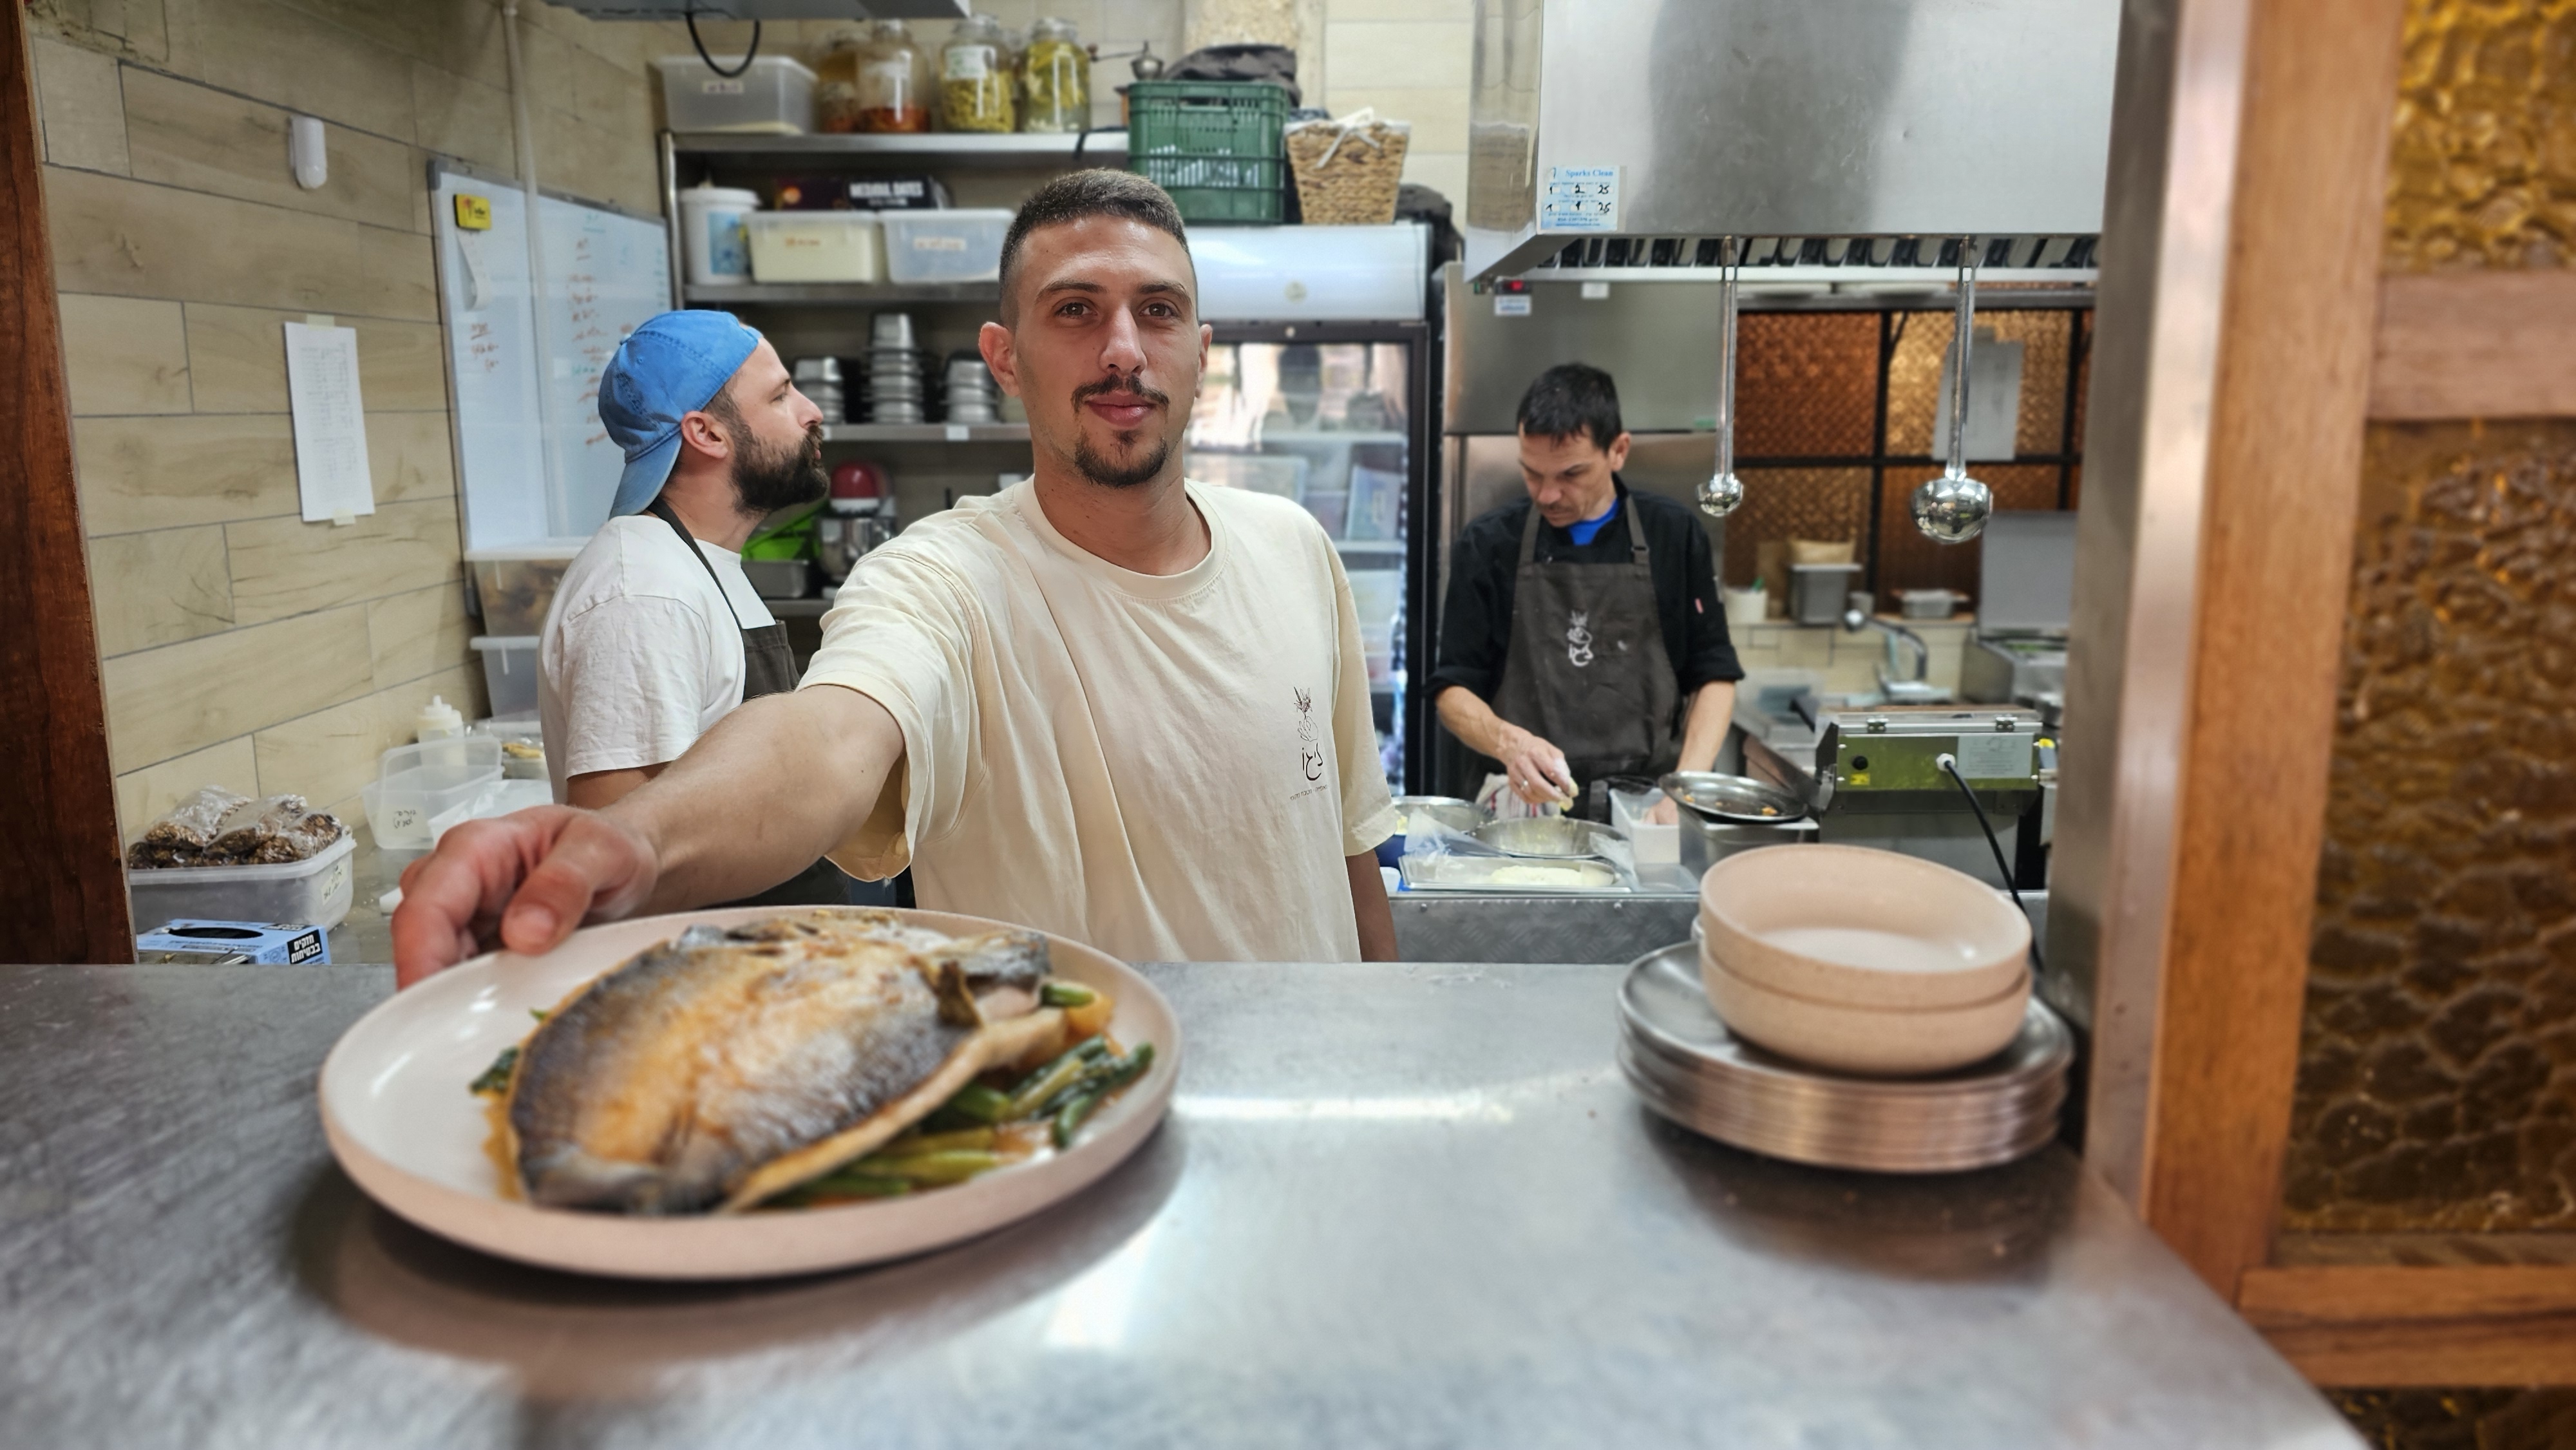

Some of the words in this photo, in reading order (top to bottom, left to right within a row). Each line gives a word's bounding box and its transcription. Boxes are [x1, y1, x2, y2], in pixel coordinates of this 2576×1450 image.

[1566, 169, 1591, 178] Sparks
[1575, 184, 1586, 194] 2
[1597, 184, 1610, 194] 25
[1598, 202, 1611, 214] 25
[293, 934, 315, 951] חזקים
[290, 942, 321, 963] בבטיחות
